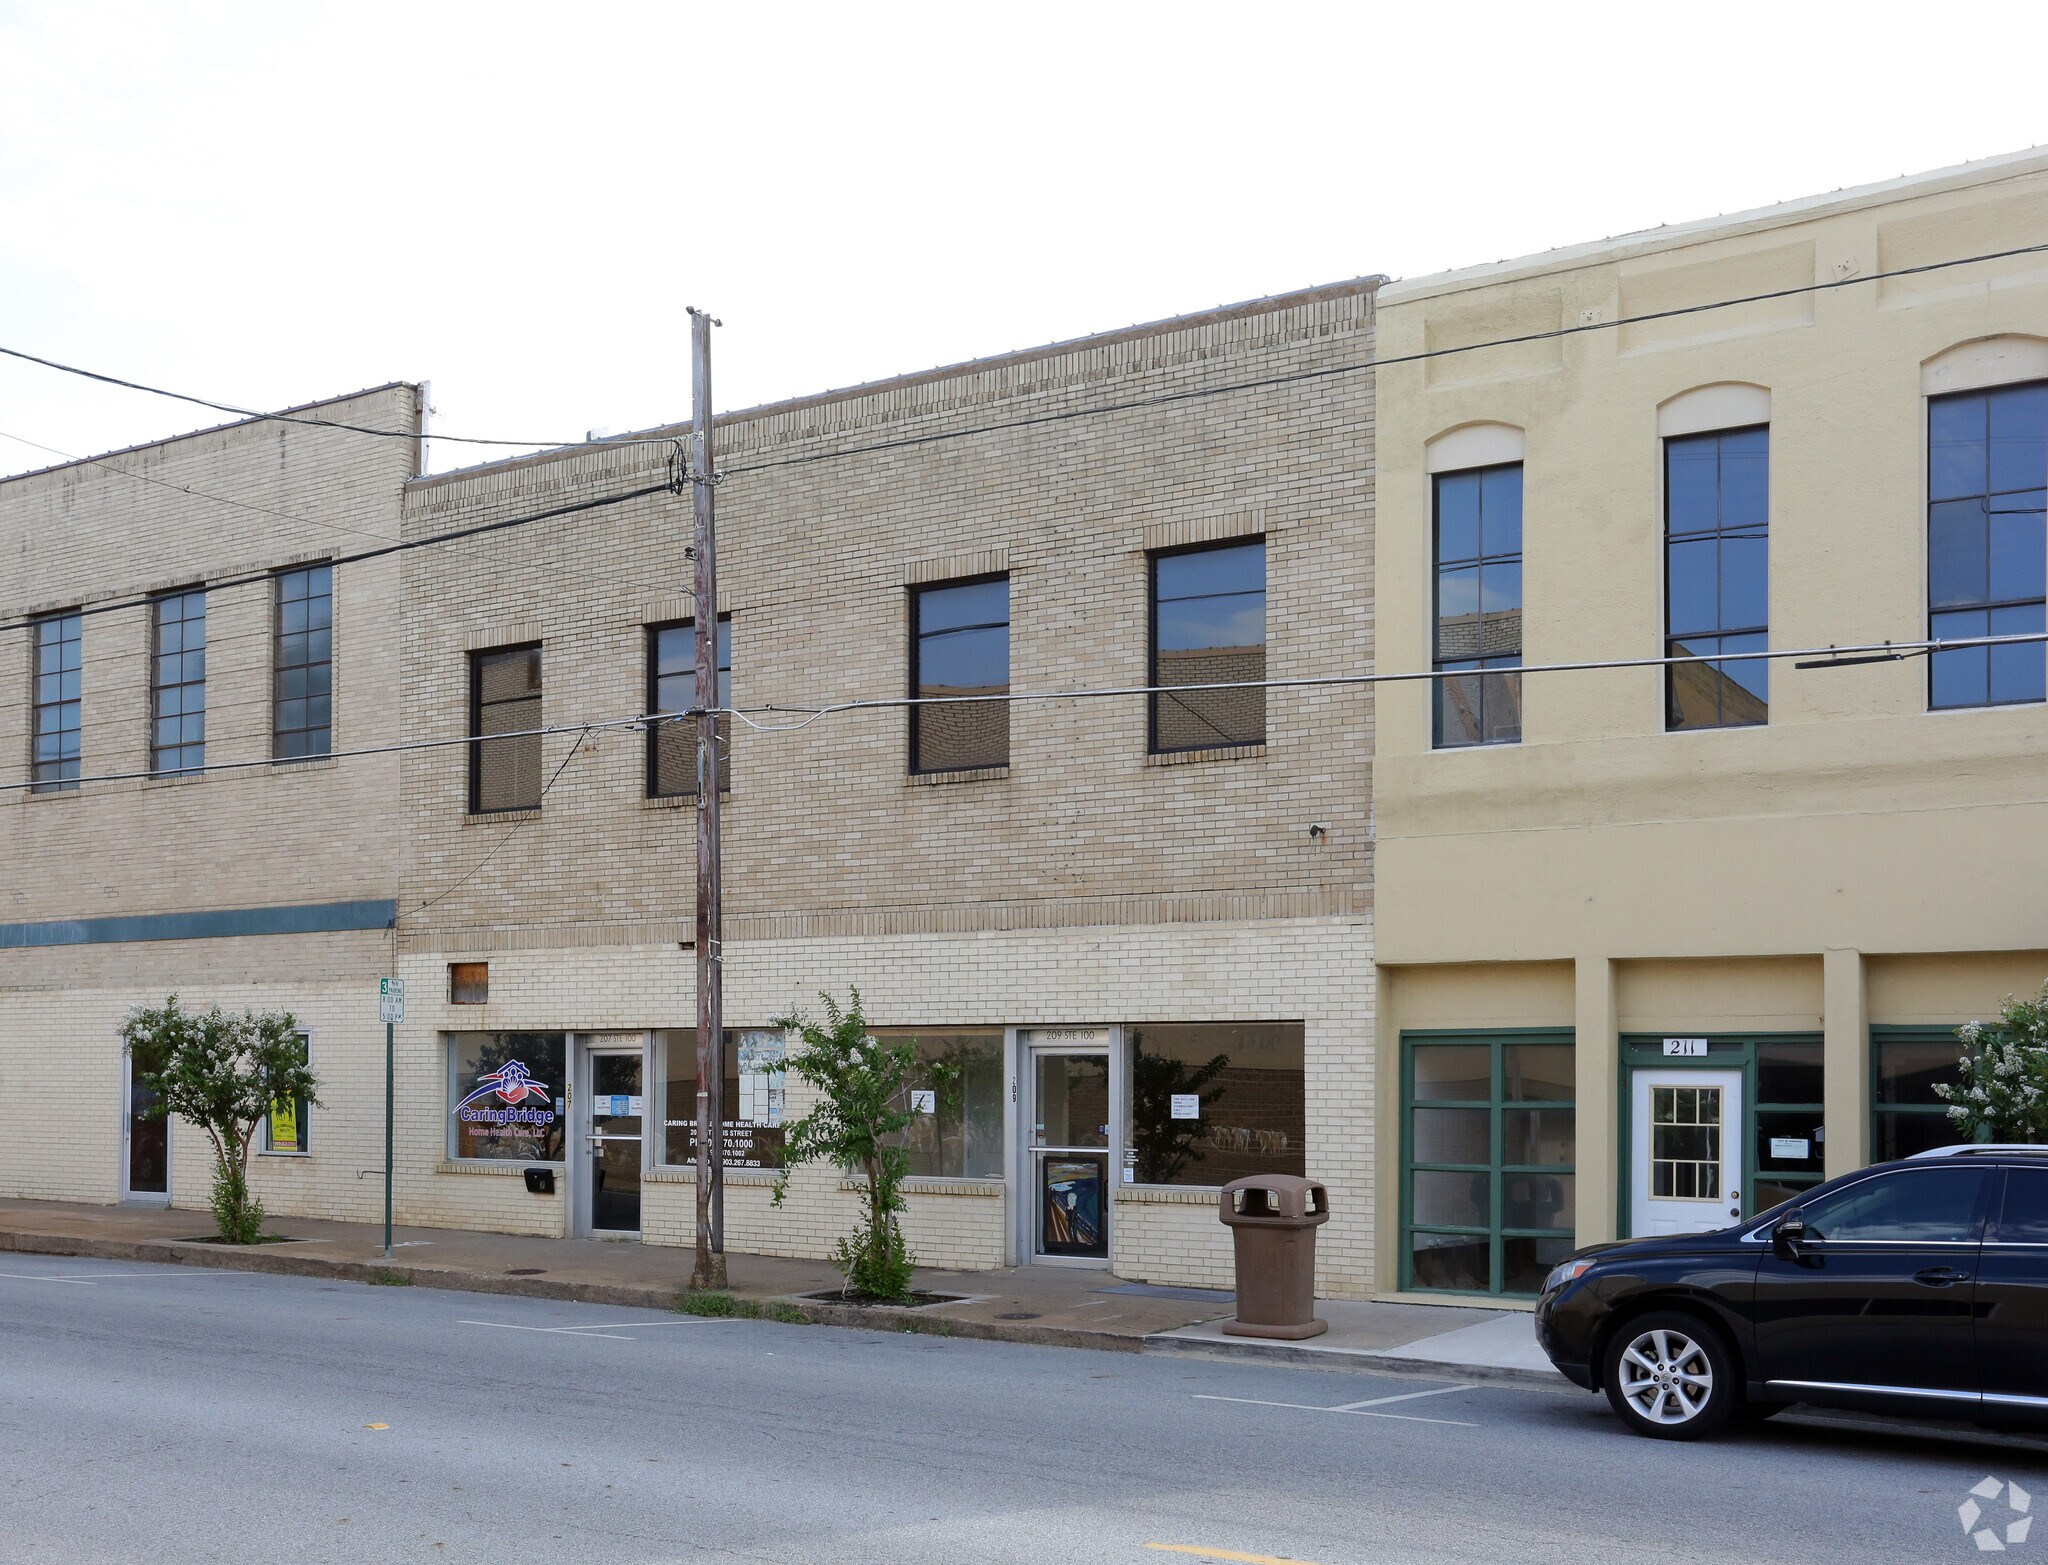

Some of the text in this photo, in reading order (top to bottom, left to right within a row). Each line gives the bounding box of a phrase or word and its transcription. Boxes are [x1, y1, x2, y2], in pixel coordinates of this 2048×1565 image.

[381, 981, 388, 993] 3
[600, 1034, 637, 1042] 207 STE 100
[1046, 1031, 1095, 1040] 209 STE 100
[1670, 1040, 1695, 1054] 211
[461, 1106, 554, 1126] CaringBridge
[735, 1121, 761, 1129] HEALTH
[469, 1127, 489, 1137] Home
[490, 1128, 512, 1137] Health
[533, 1129, 545, 1138] LLC
[729, 1130, 752, 1138] STREET
